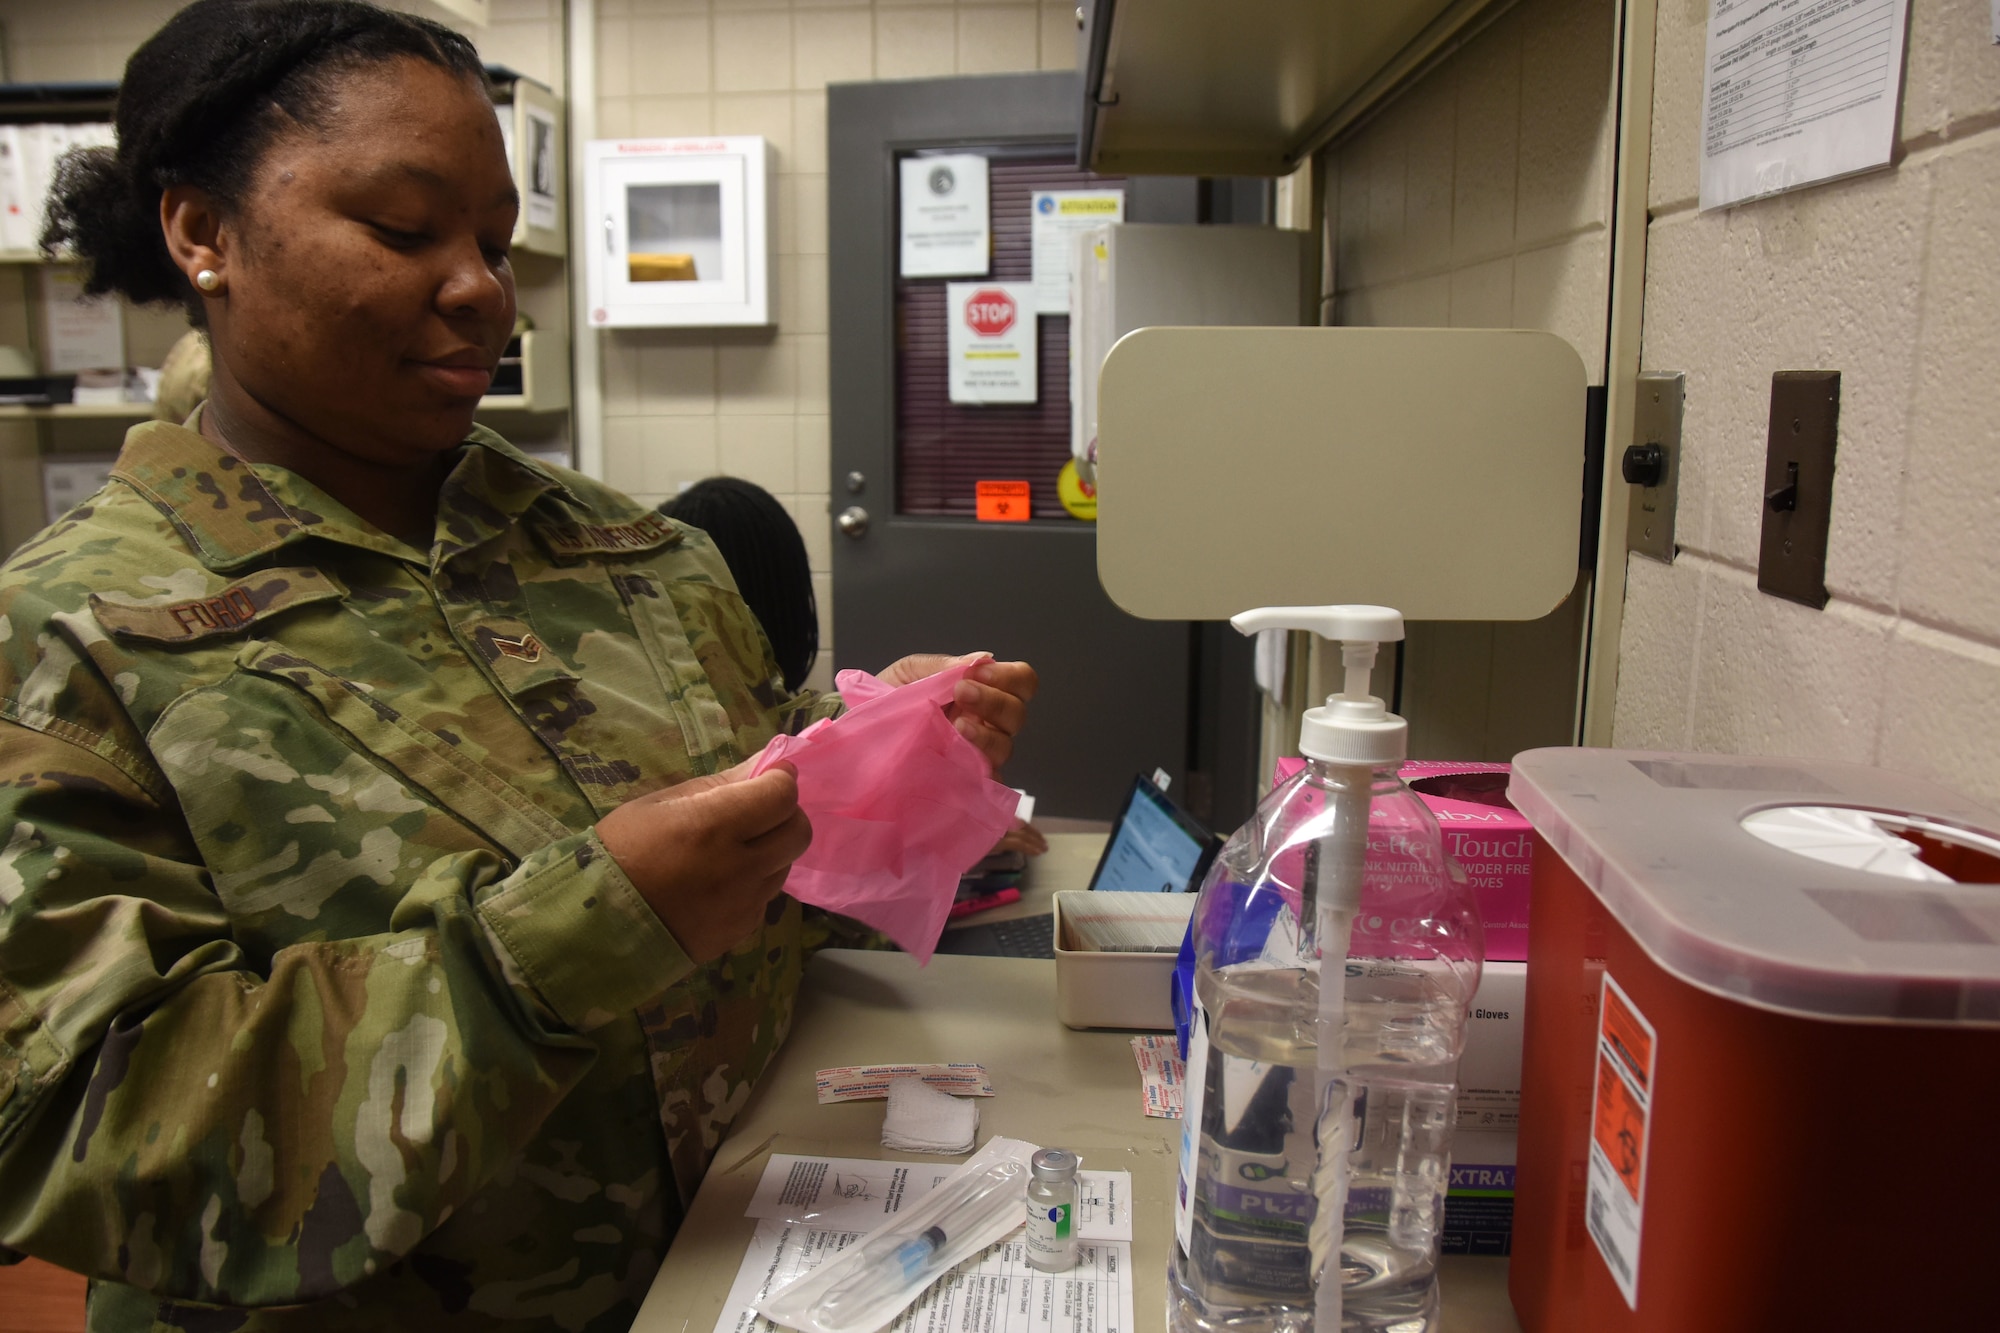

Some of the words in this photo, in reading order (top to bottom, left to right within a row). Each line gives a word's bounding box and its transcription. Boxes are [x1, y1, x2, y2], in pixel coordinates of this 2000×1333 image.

[969, 303, 1011, 324] STOP
[603, 516, 673, 548] FORCE
[169, 587, 256, 634] FORD
[1448, 832, 1533, 859] Touch
[1461, 863, 1502, 875] WDER
[1505, 864, 1530, 875] FRE
[1363, 874, 1442, 888] AMINATION
[1470, 877, 1504, 888] OVES
[1483, 921, 1507, 930] Central
[1476, 1009, 1509, 1020] Gloves
[816, 1232, 828, 1250] Smallpox
[838, 1234, 848, 1246] Yellow
[1004, 1244, 1012, 1262] Influenza
[1108, 1255, 1116, 1273] VACCINE
[955, 1275, 965, 1289] testing
[967, 1279, 975, 1295] lifetime
[1000, 1278, 1008, 1294] Annually
[965, 1296, 973, 1308] doses
[986, 1277, 996, 1311] Baseline/medical
[739, 1312, 748, 1321] with
[972, 1295, 984, 1332] duty/deployment
[1041, 1309, 1049, 1321] dose)
